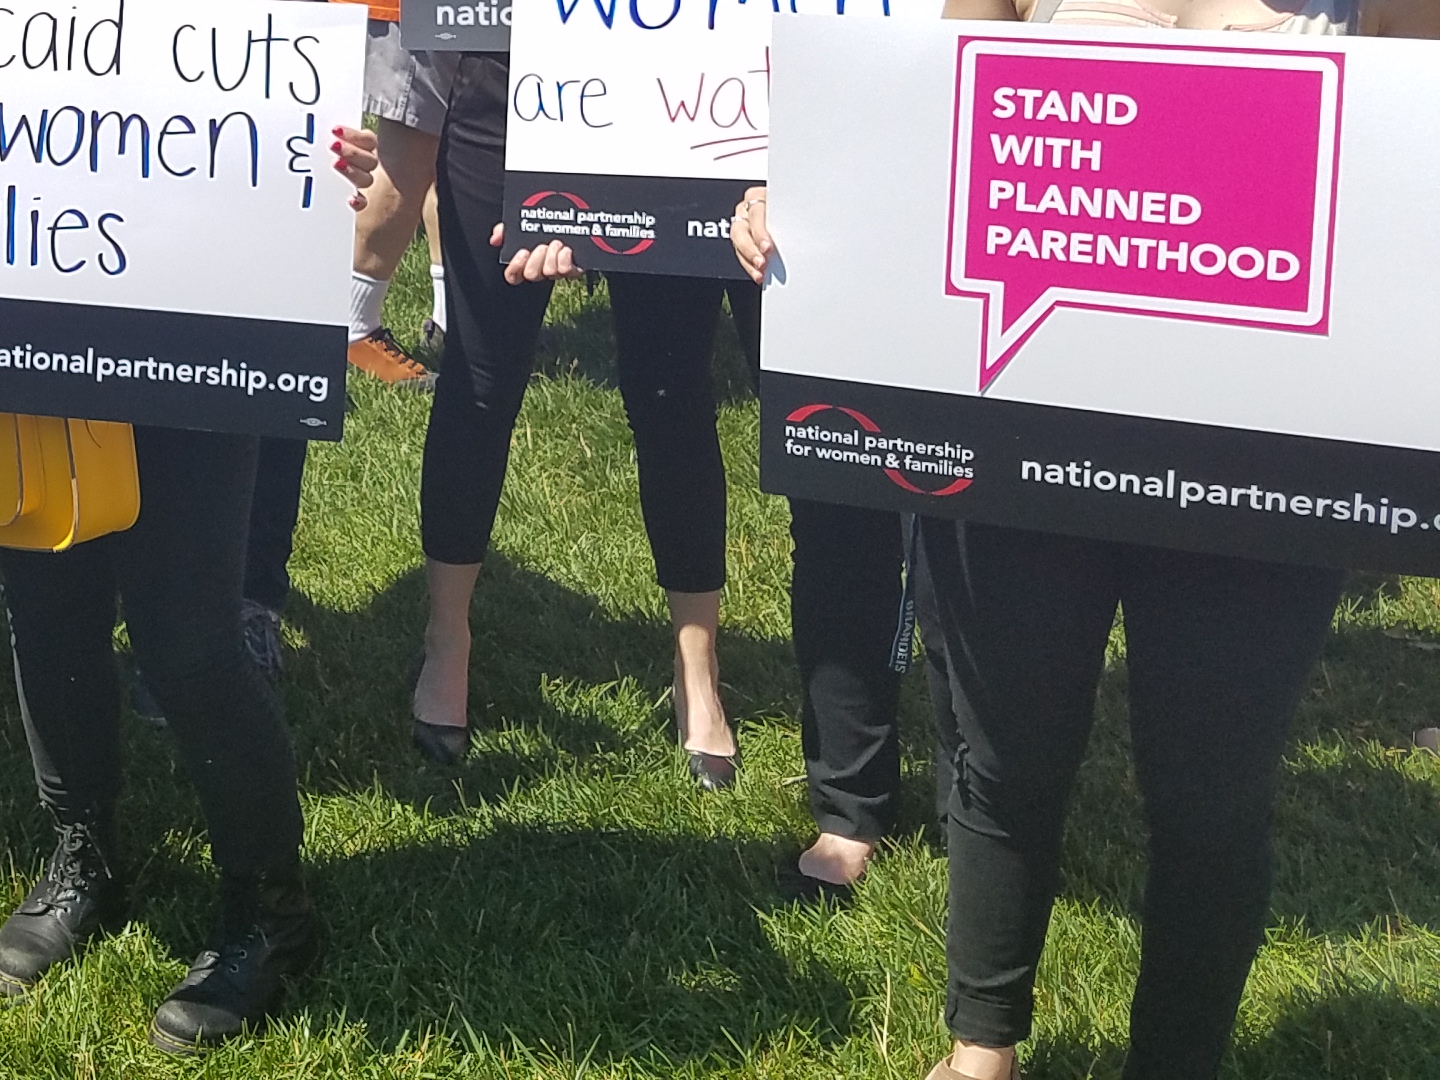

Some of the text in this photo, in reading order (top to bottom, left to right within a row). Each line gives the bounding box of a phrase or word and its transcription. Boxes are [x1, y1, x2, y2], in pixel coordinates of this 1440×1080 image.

[172, 13, 321, 105] cuts
[514, 73, 613, 128] are
[991, 86, 1138, 126] STAND
[989, 133, 1102, 171] WITH
[988, 179, 1202, 226] PLANNED
[521, 207, 740, 239] national partnership nat
[521, 220, 656, 239] for women & families
[985, 224, 1300, 282] PARENTHOOD
[785, 424, 974, 462] national partnership
[785, 439, 974, 479] for women & families
